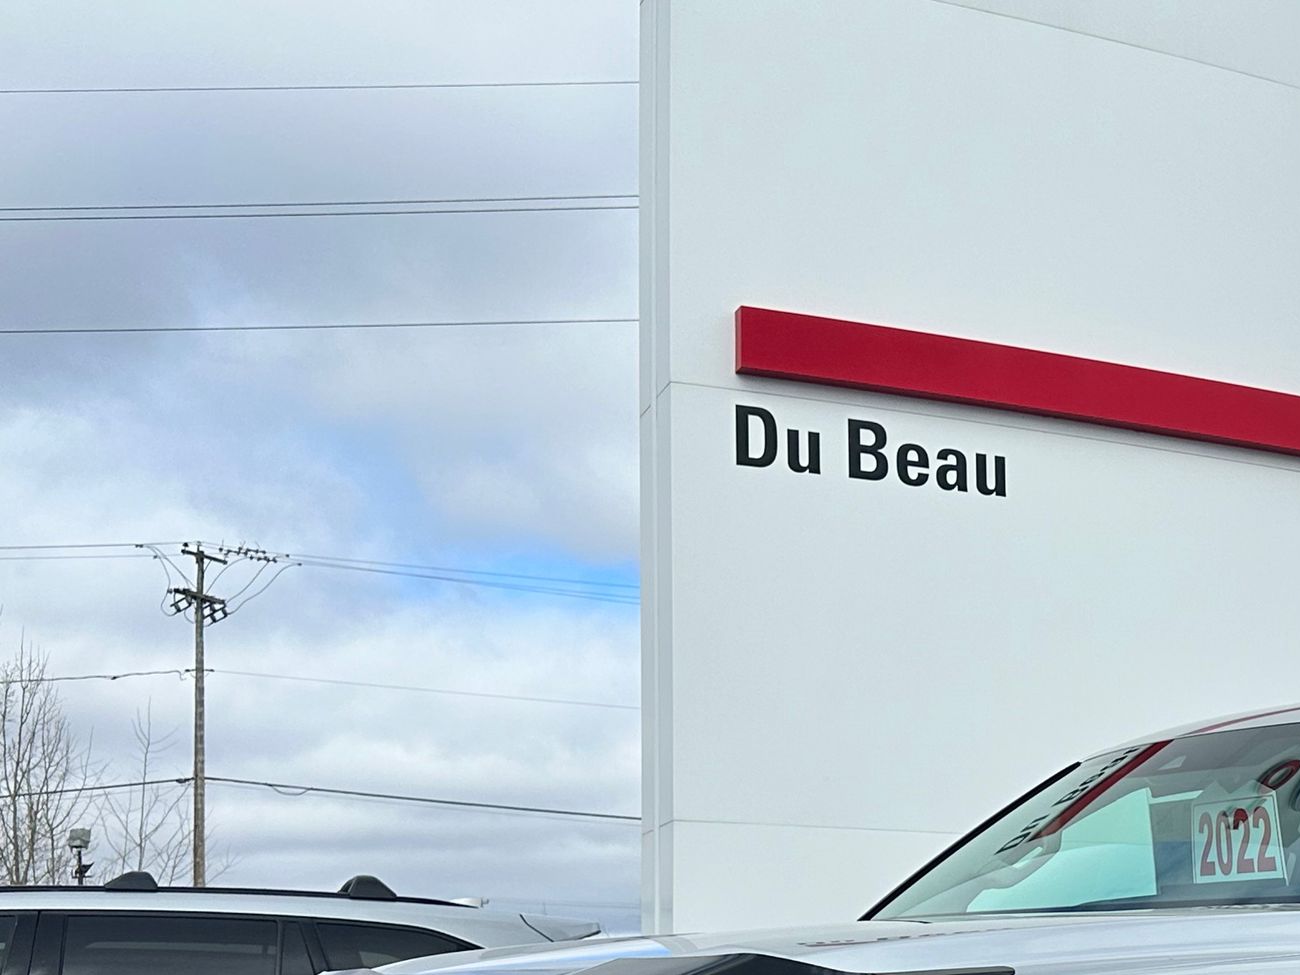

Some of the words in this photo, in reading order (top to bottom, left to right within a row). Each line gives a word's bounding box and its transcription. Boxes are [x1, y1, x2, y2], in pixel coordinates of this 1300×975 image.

[735, 404, 821, 475] Du
[848, 418, 1007, 498] Beau
[1198, 805, 1277, 877] 2022
